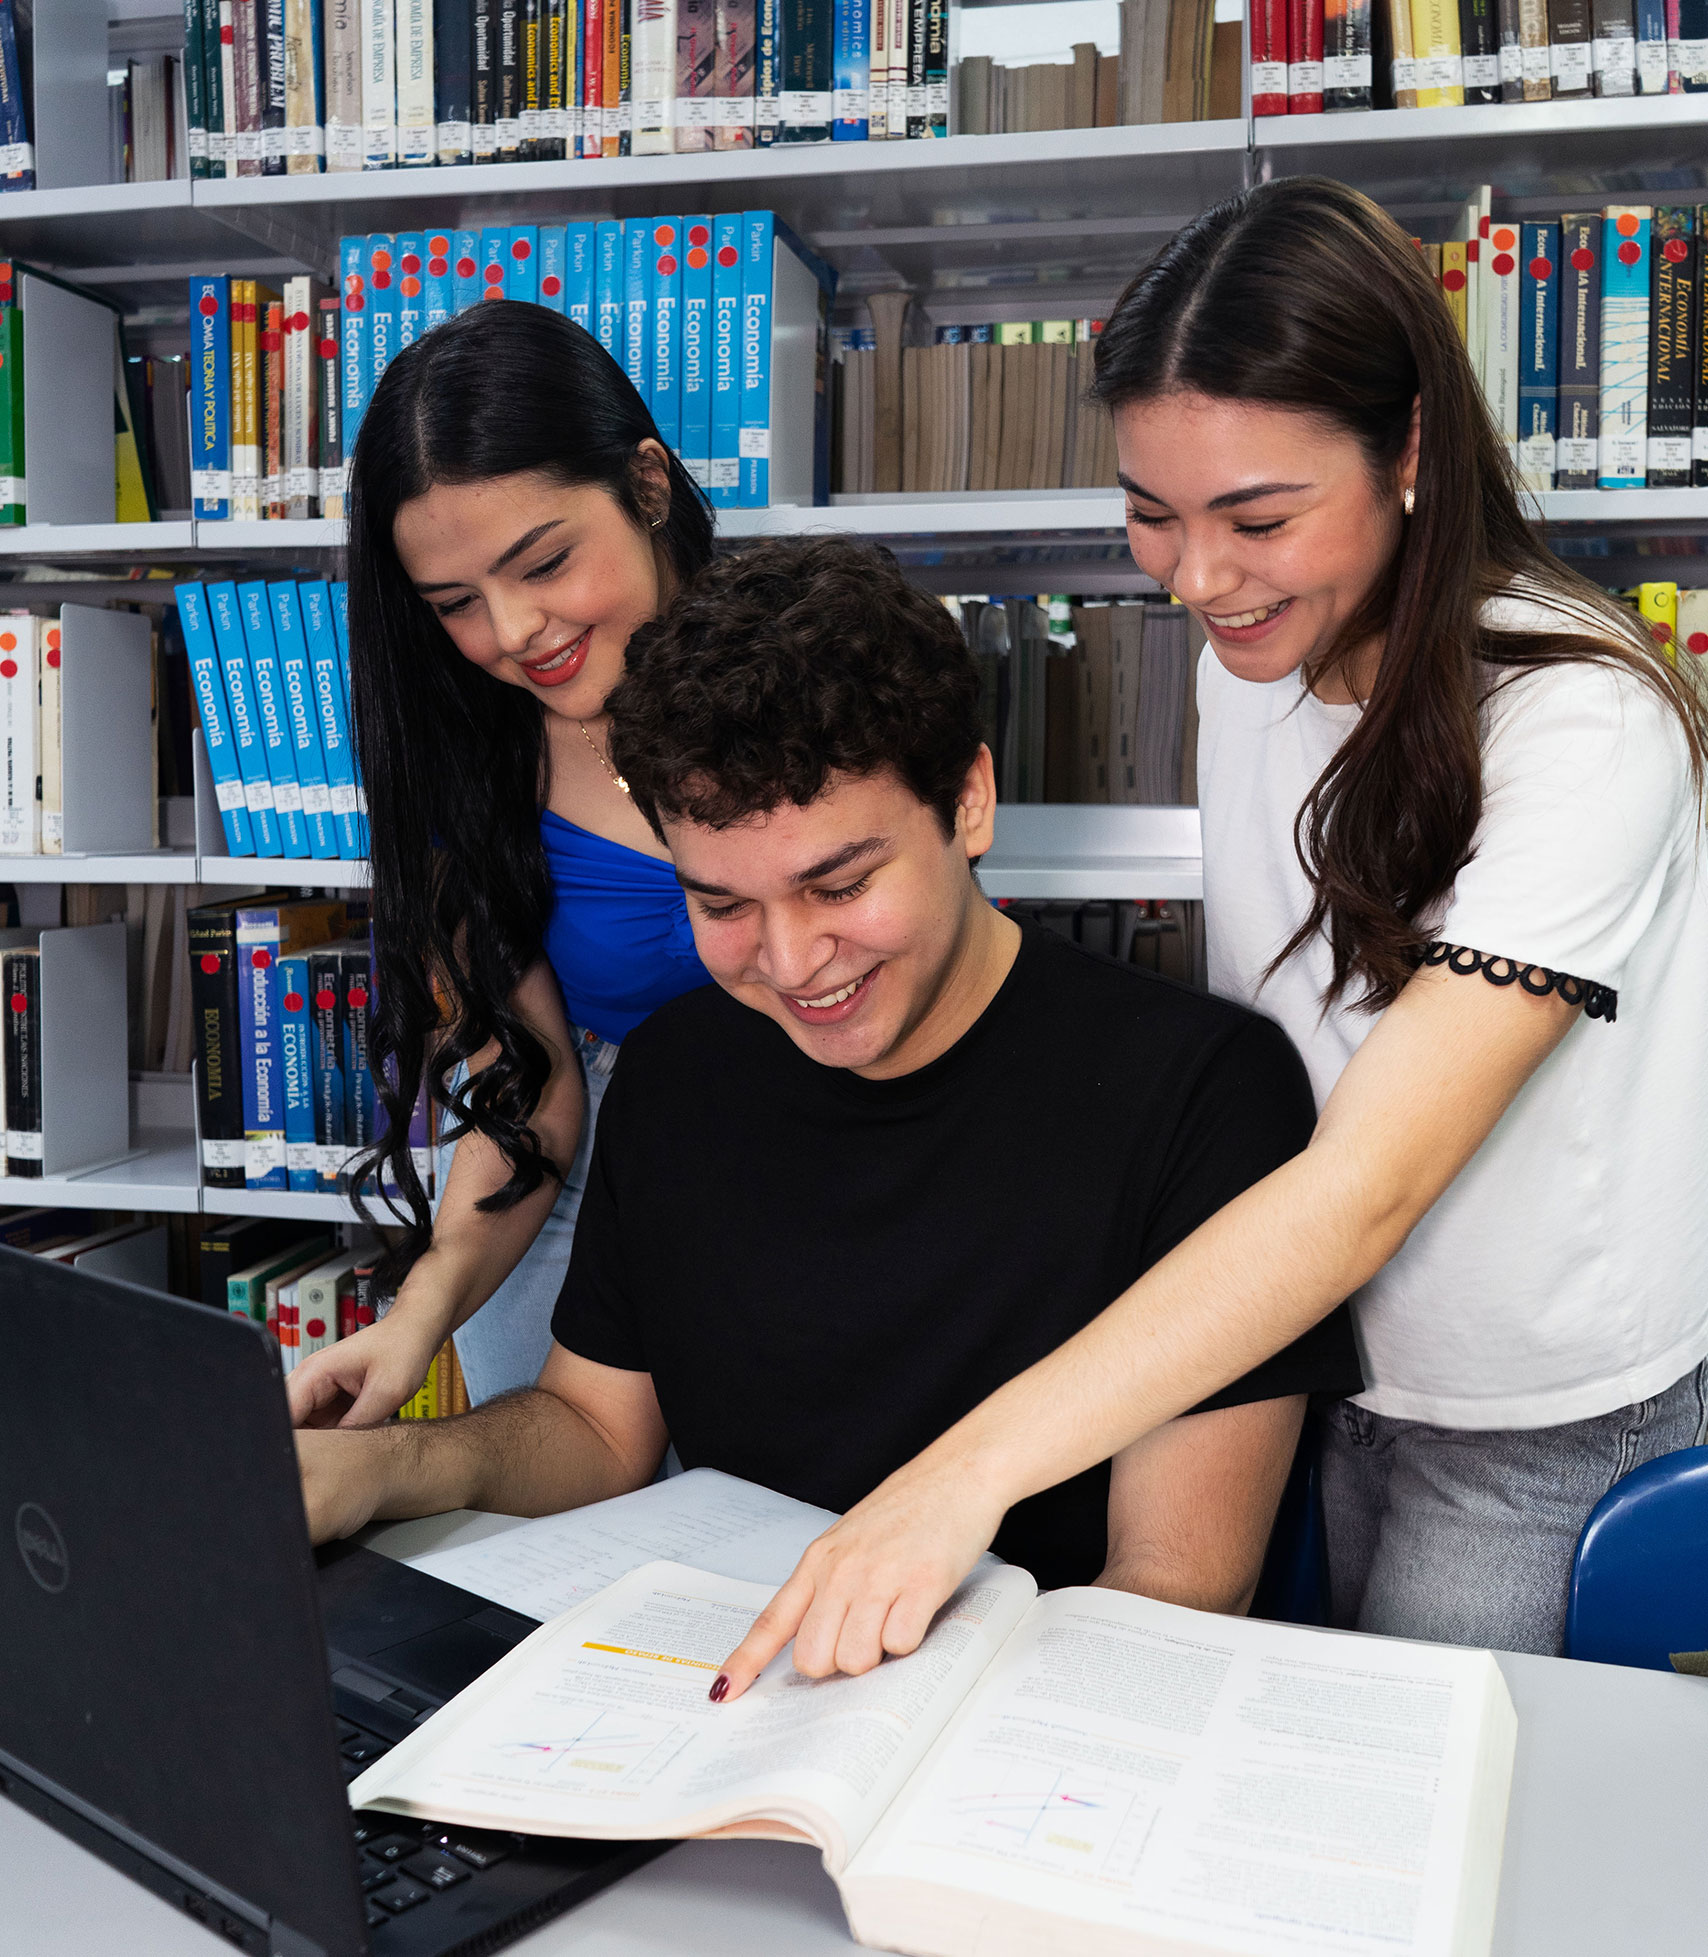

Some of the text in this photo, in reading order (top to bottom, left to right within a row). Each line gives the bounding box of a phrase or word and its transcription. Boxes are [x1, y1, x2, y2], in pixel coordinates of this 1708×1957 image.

[372, 0, 386, 84] NOMÍA DE EMPRESA
[410, 0, 424, 81] OMÍA DE EMPRESA
[475, 15, 490, 71] Oportunidad
[501, 11, 516, 66] Oportunidad
[550, 17, 561, 73] Economics
[760, 0, 775, 98] cipios de Econo
[842, 20, 850, 58] edition
[851, 0, 863, 58] nomics
[912, 8, 923, 86] EMPRESA
[930, 0, 944, 54] nomía
[266, 37, 286, 109] PROBLEM
[527, 23, 538, 101] Economics and
[550, 74, 561, 95] and
[621, 34, 632, 90] Economía
[489, 239, 502, 265] Park
[574, 234, 586, 272] Parkin
[602, 232, 615, 272] Parkin
[632, 230, 644, 269] Parkin
[720, 226, 734, 248] Par
[750, 222, 764, 262] Parkin
[200, 284, 215, 350] ECOMIA
[599, 303, 618, 353] Econ
[1656, 254, 1674, 385] INTERNACIONAL
[1674, 278, 1692, 360] ECONOMÍA
[231, 352, 241, 368] XXI
[244, 352, 254, 368] XXI
[346, 317, 364, 408] Economía
[373, 313, 392, 382] Econo
[656, 297, 676, 392] Economía
[686, 298, 706, 394] Economía
[717, 296, 737, 392] Economía
[745, 294, 766, 390] Economía
[204, 390, 215, 400] Y
[231, 390, 241, 403] del
[232, 370, 242, 388] siglo
[244, 370, 255, 388] siglo
[244, 390, 254, 403] del
[327, 359, 336, 408] BUSINESS
[328, 409, 336, 443] FUNKY
[750, 458, 758, 495] PEARSON
[184, 592, 202, 631] Parkin
[216, 592, 234, 630] Parkin
[247, 592, 264, 630] Parkin
[278, 593, 292, 631] Parkin
[308, 593, 323, 631] Parkin
[195, 658, 226, 748] Economía
[226, 658, 255, 748] Economía
[255, 658, 284, 748] Economía
[285, 658, 313, 750] Economía
[315, 658, 342, 750] Economía
[231, 810, 242, 842] PEARSON
[260, 810, 270, 844] PEARSON
[288, 812, 298, 844] PEARSON
[316, 813, 326, 846] PEARSON
[344, 814, 354, 847] PEARSON
[252, 946, 272, 1026] Ioducción
[204, 1008, 222, 1101] ECONOMIA
[256, 1042, 271, 1054] la
[282, 1024, 302, 1109] ECONOMÍA
[20, 1054, 29, 1098] NACIONES
[256, 1058, 274, 1122] Economía
[302, 1099, 310, 1109] LA
[624, 1648, 660, 1662] REPASO
[662, 1655, 673, 1663] DE
